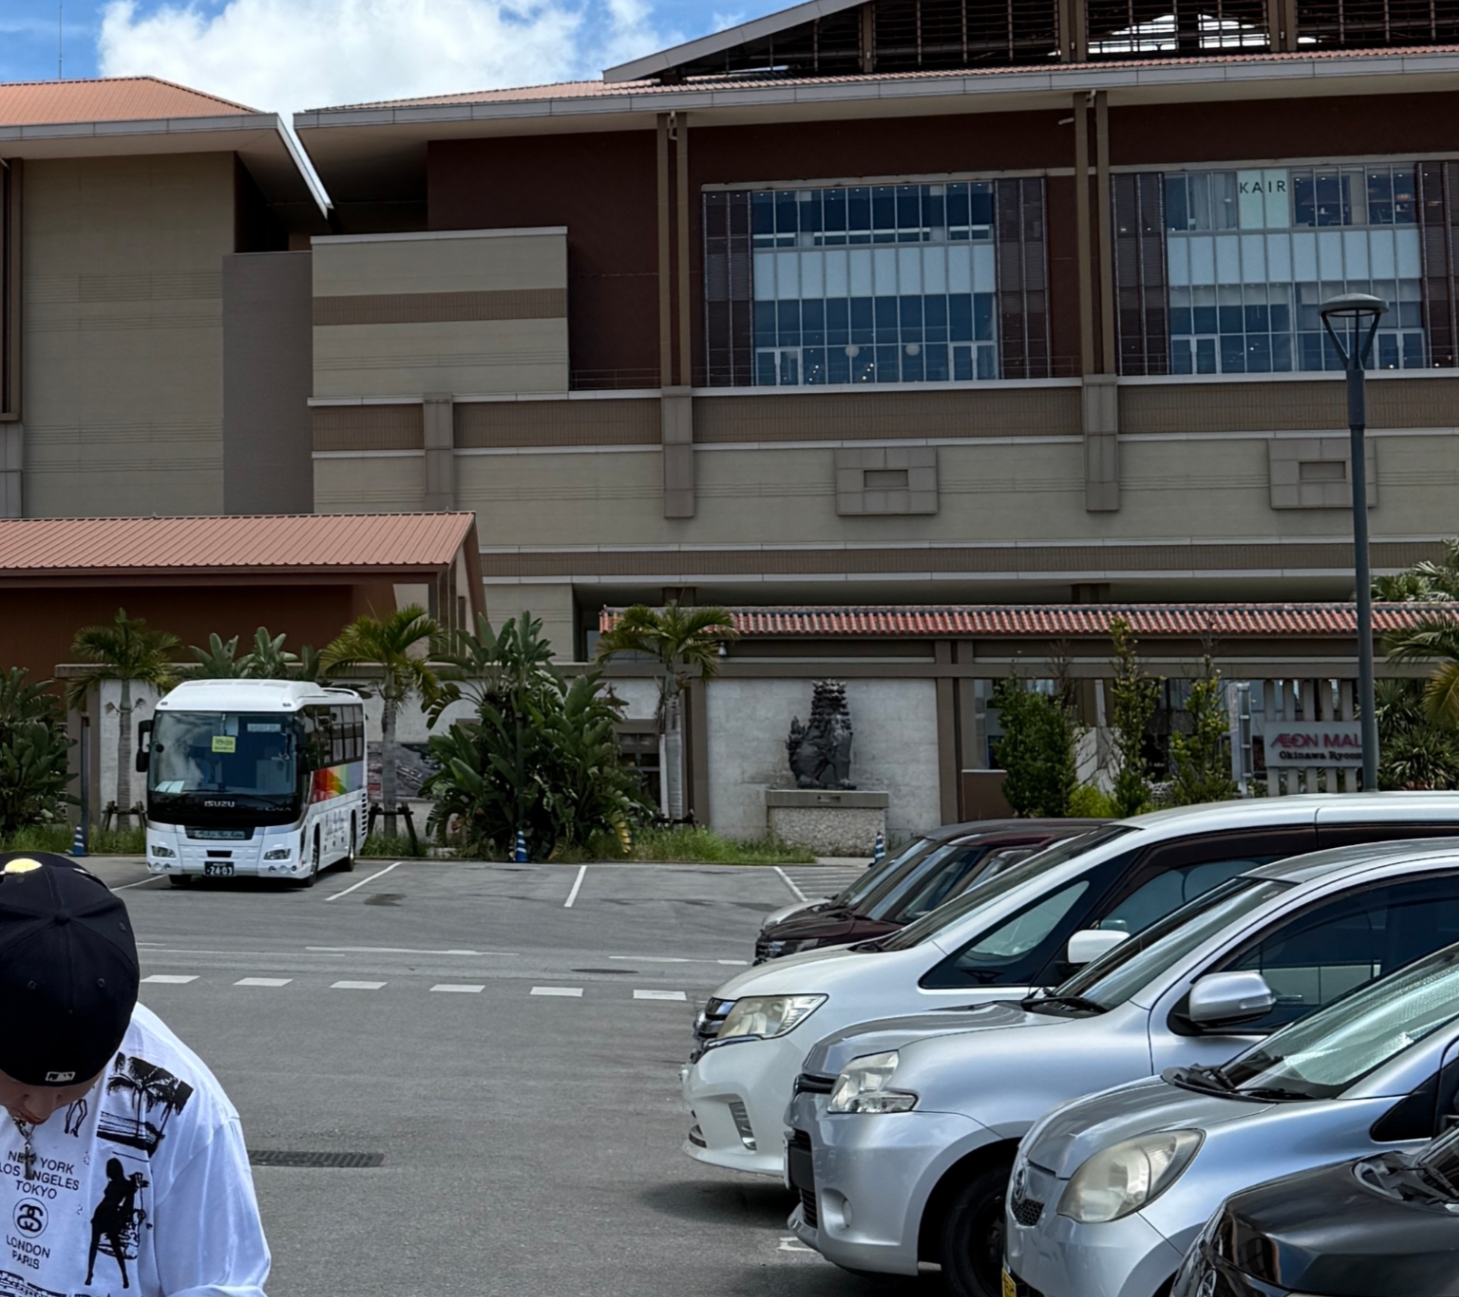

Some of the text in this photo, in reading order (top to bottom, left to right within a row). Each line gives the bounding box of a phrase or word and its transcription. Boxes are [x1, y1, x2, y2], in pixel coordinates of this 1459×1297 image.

[1323, 733, 1362, 749] MAL
[1279, 750, 1327, 760] Okinawa
[204, 800, 236, 808] ISUZU
[40, 1157, 75, 1175] YORK
[26, 1168, 80, 1191] NGELES
[16, 1180, 58, 1200] TOKYO
[6, 1235, 51, 1259] LONDON
[12, 1250, 40, 1270] PARIS
